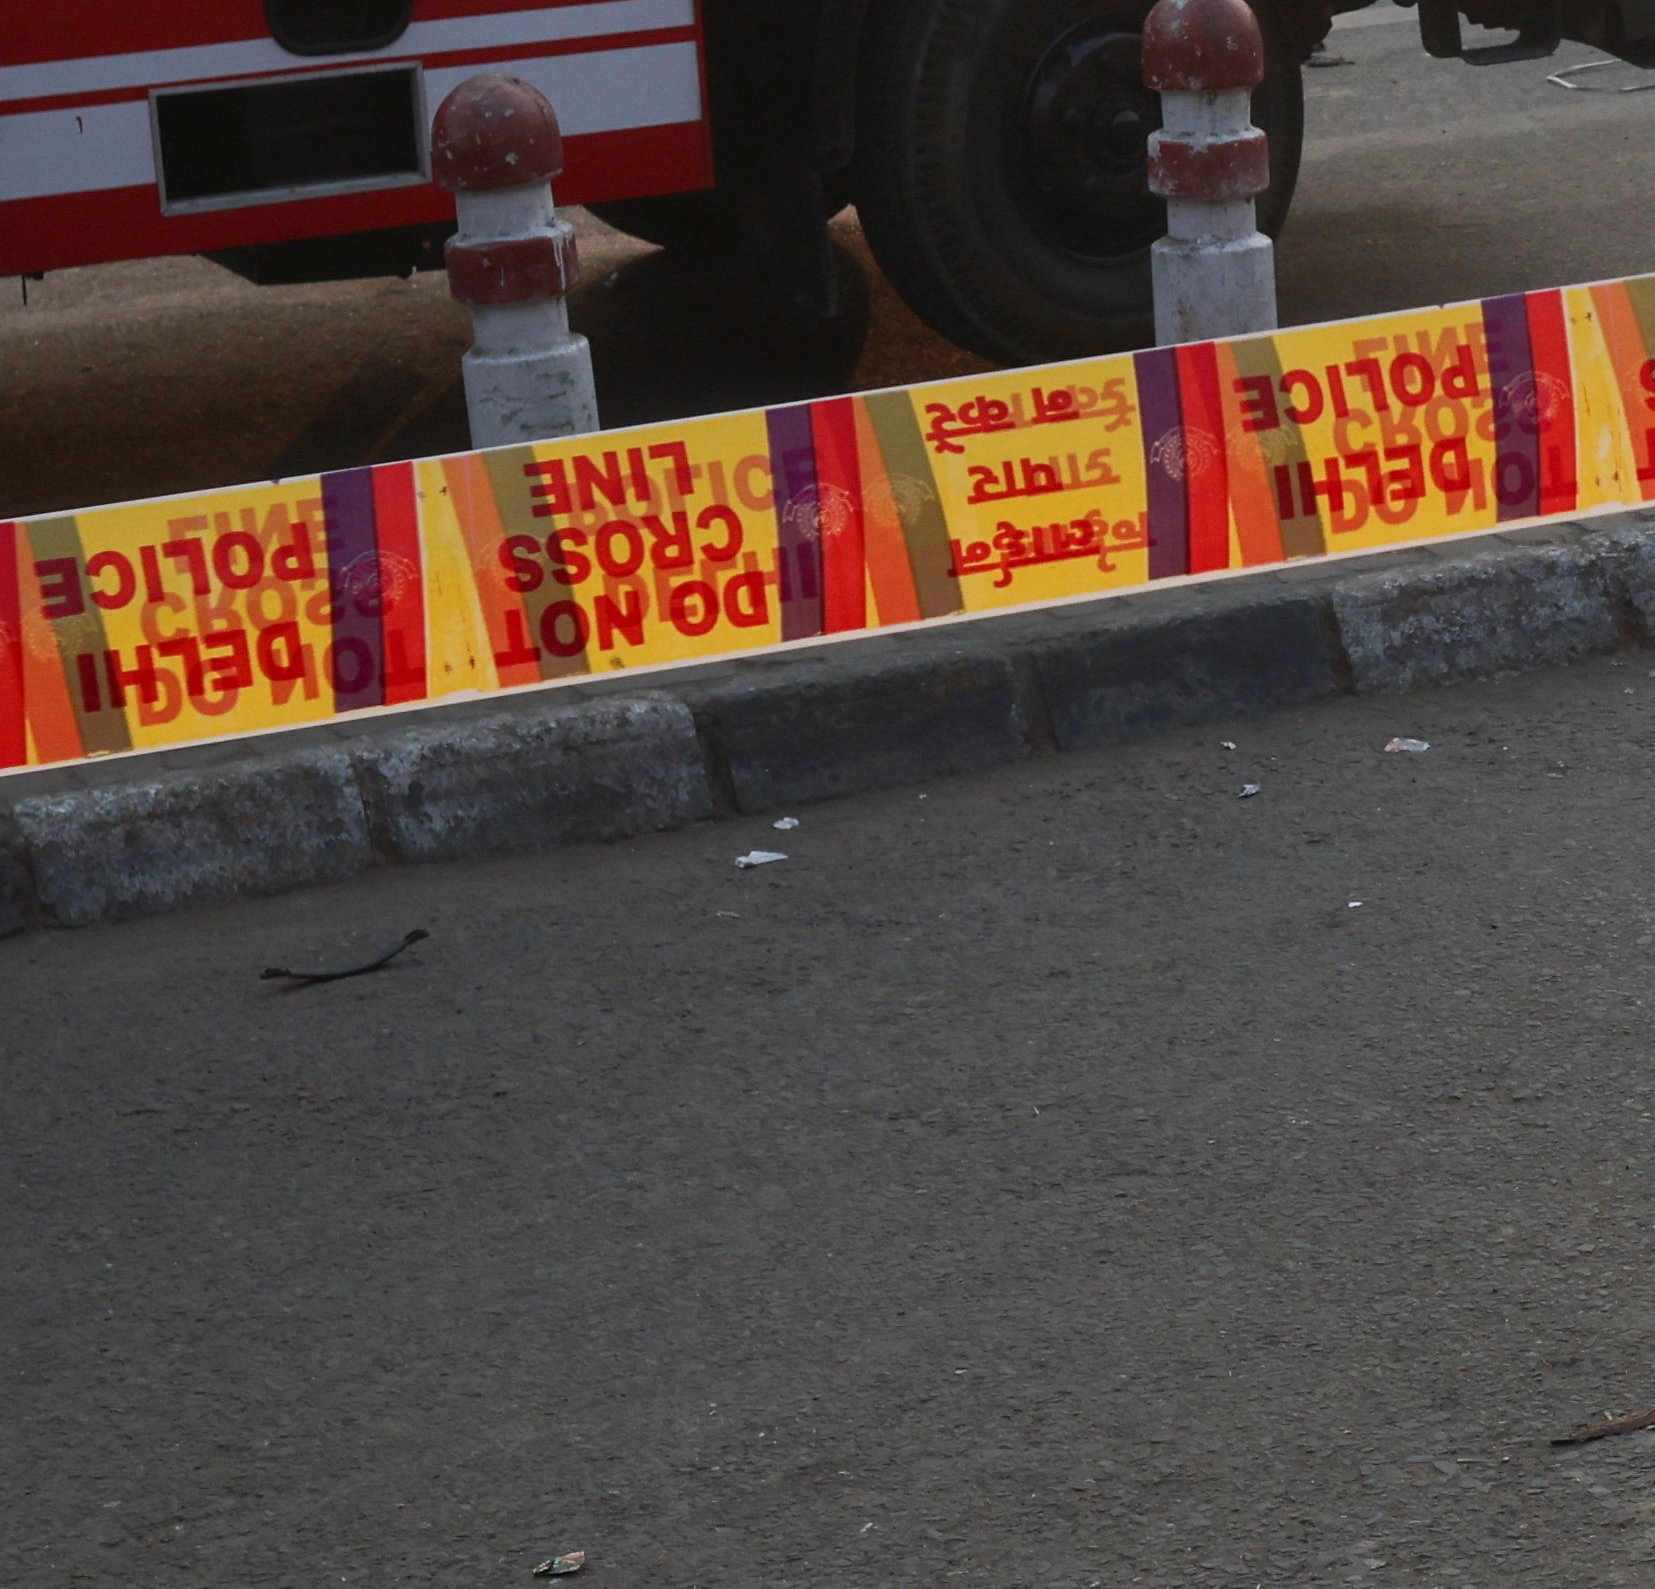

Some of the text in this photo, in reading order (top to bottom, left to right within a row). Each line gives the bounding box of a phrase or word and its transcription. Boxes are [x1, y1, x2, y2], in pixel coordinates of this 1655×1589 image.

[924, 387, 1080, 454] न करें
[1232, 344, 1480, 434] POLICE
[522, 440, 694, 518] LINE
[968, 458, 1064, 504] पार
[1274, 436, 1472, 521] DELHI
[33, 522, 315, 620] POLICE
[498, 504, 743, 594] CROSS
[946, 519, 1102, 588] लाईन
[494, 571, 769, 668] DO NOT
[76, 621, 305, 714] DELHI
